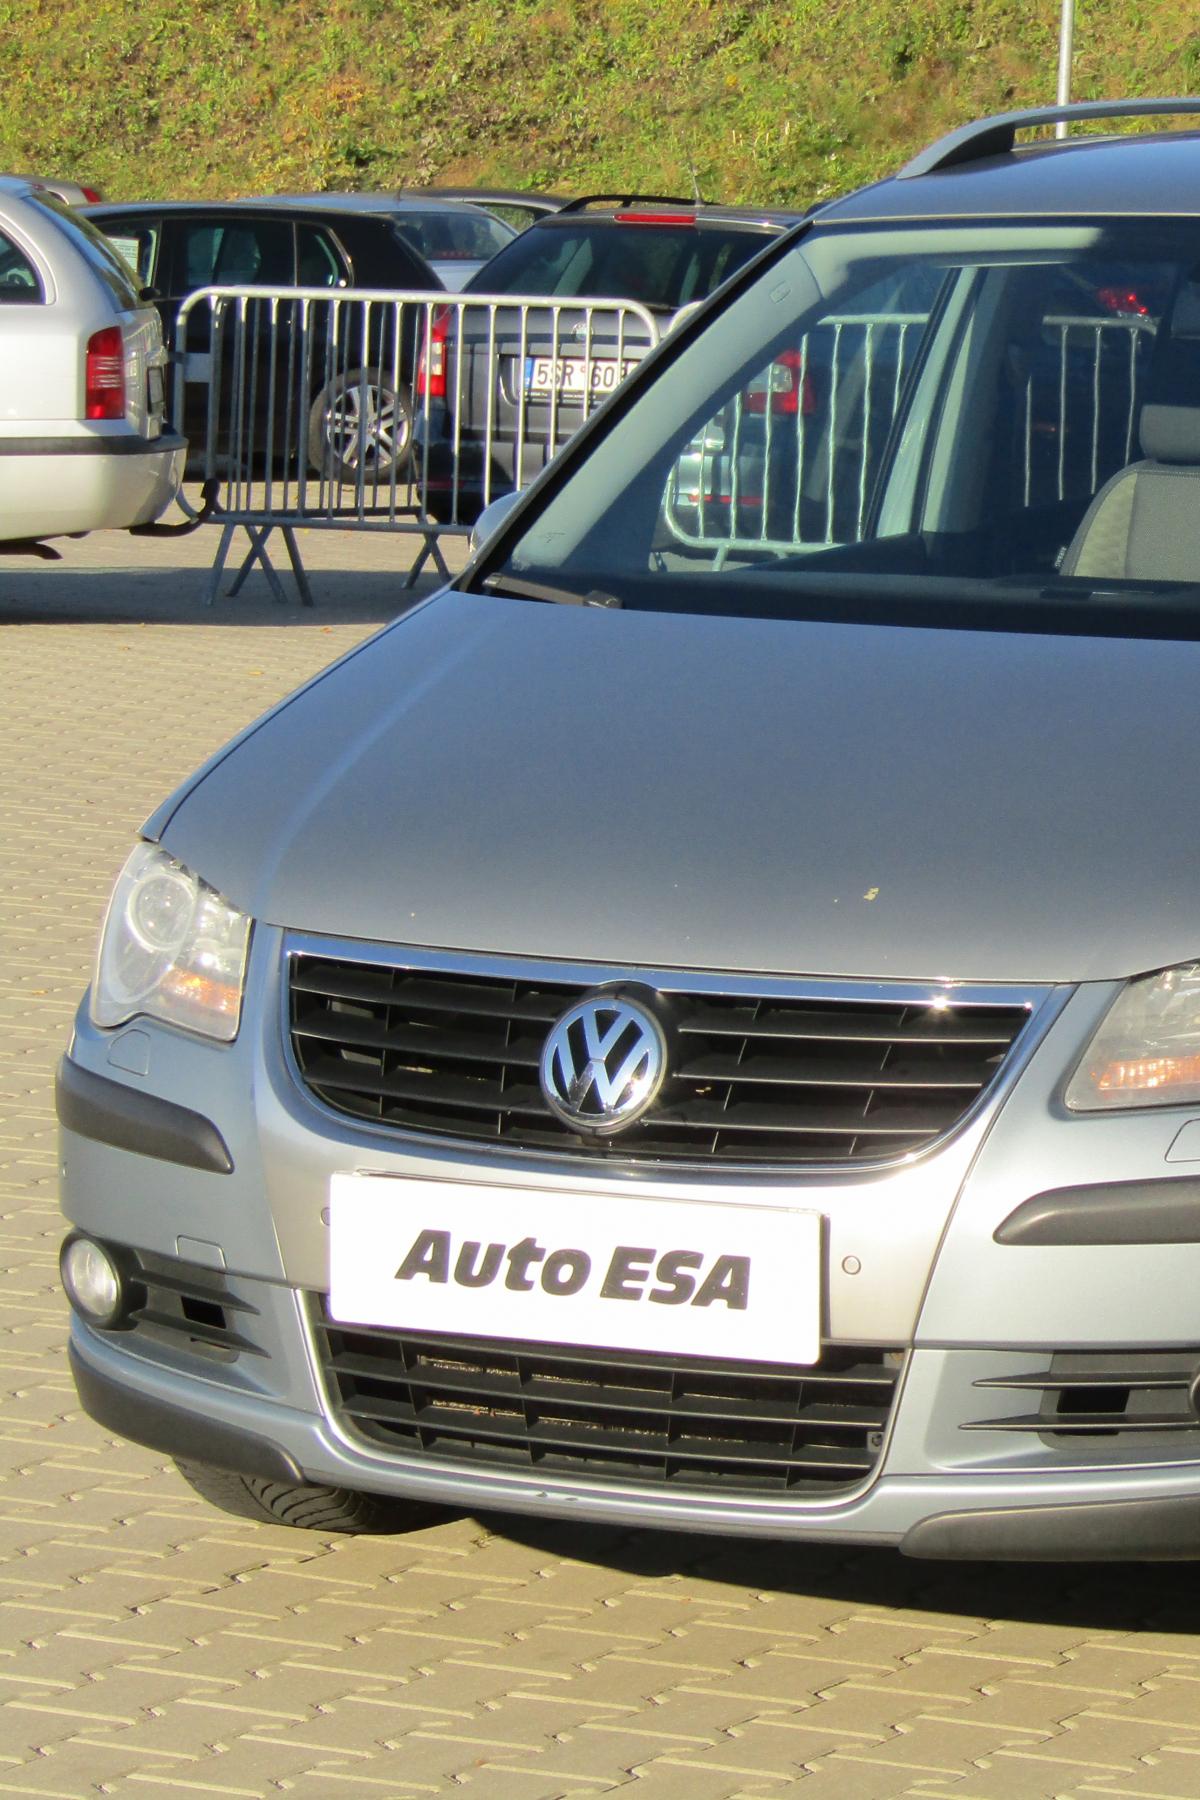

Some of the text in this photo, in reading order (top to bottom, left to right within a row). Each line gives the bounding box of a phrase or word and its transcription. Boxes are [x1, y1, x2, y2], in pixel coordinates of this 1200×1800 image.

[546, 998, 660, 1120] VW
[395, 1229, 750, 1311] Auto ESA
